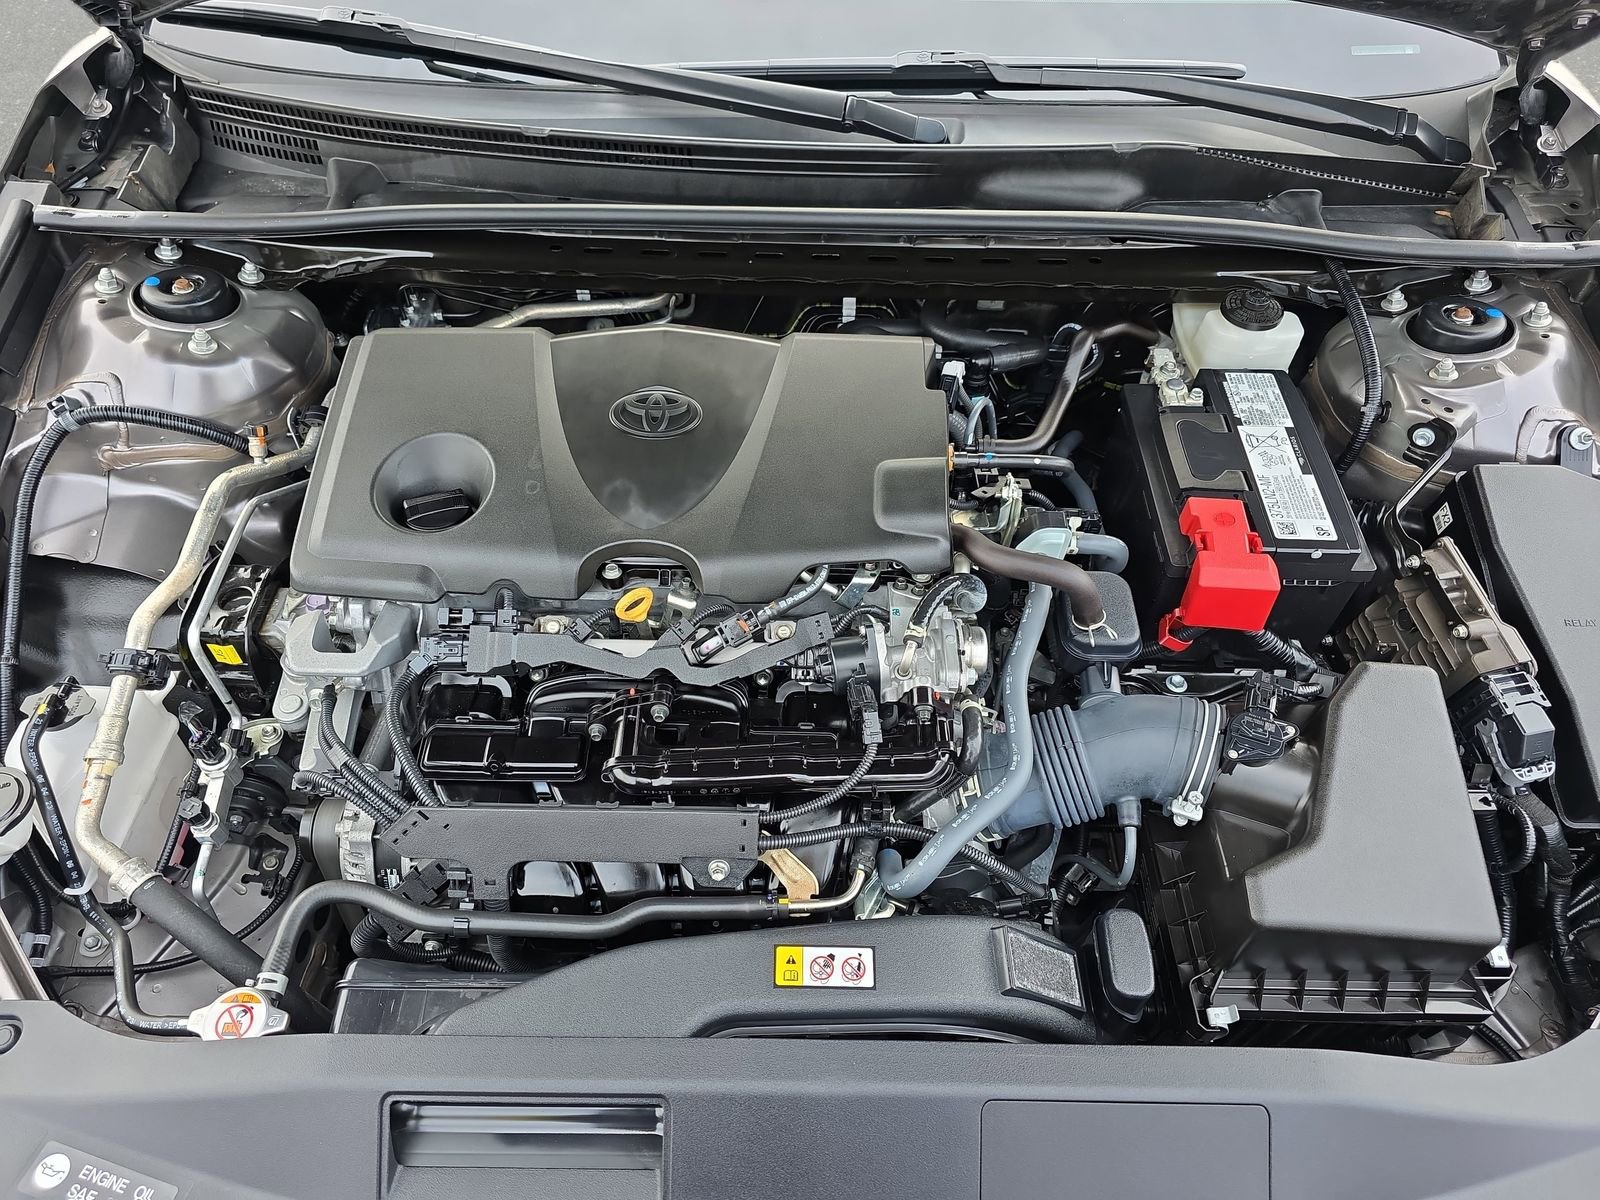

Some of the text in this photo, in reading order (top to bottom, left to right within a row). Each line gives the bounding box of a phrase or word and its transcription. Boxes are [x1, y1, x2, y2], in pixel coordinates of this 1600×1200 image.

[1257, 474, 1284, 519] 375LN2-MF
[1440, 504, 1450, 527] FX2
[1316, 526, 1331, 537] SP
[1563, 618, 1597, 628] RELAY
[50, 813, 63, 837] WATER
[139, 1020, 163, 1030] WATER
[78, 1164, 155, 1200] ENGINE OIL
[67, 1184, 99, 1200] SAE
